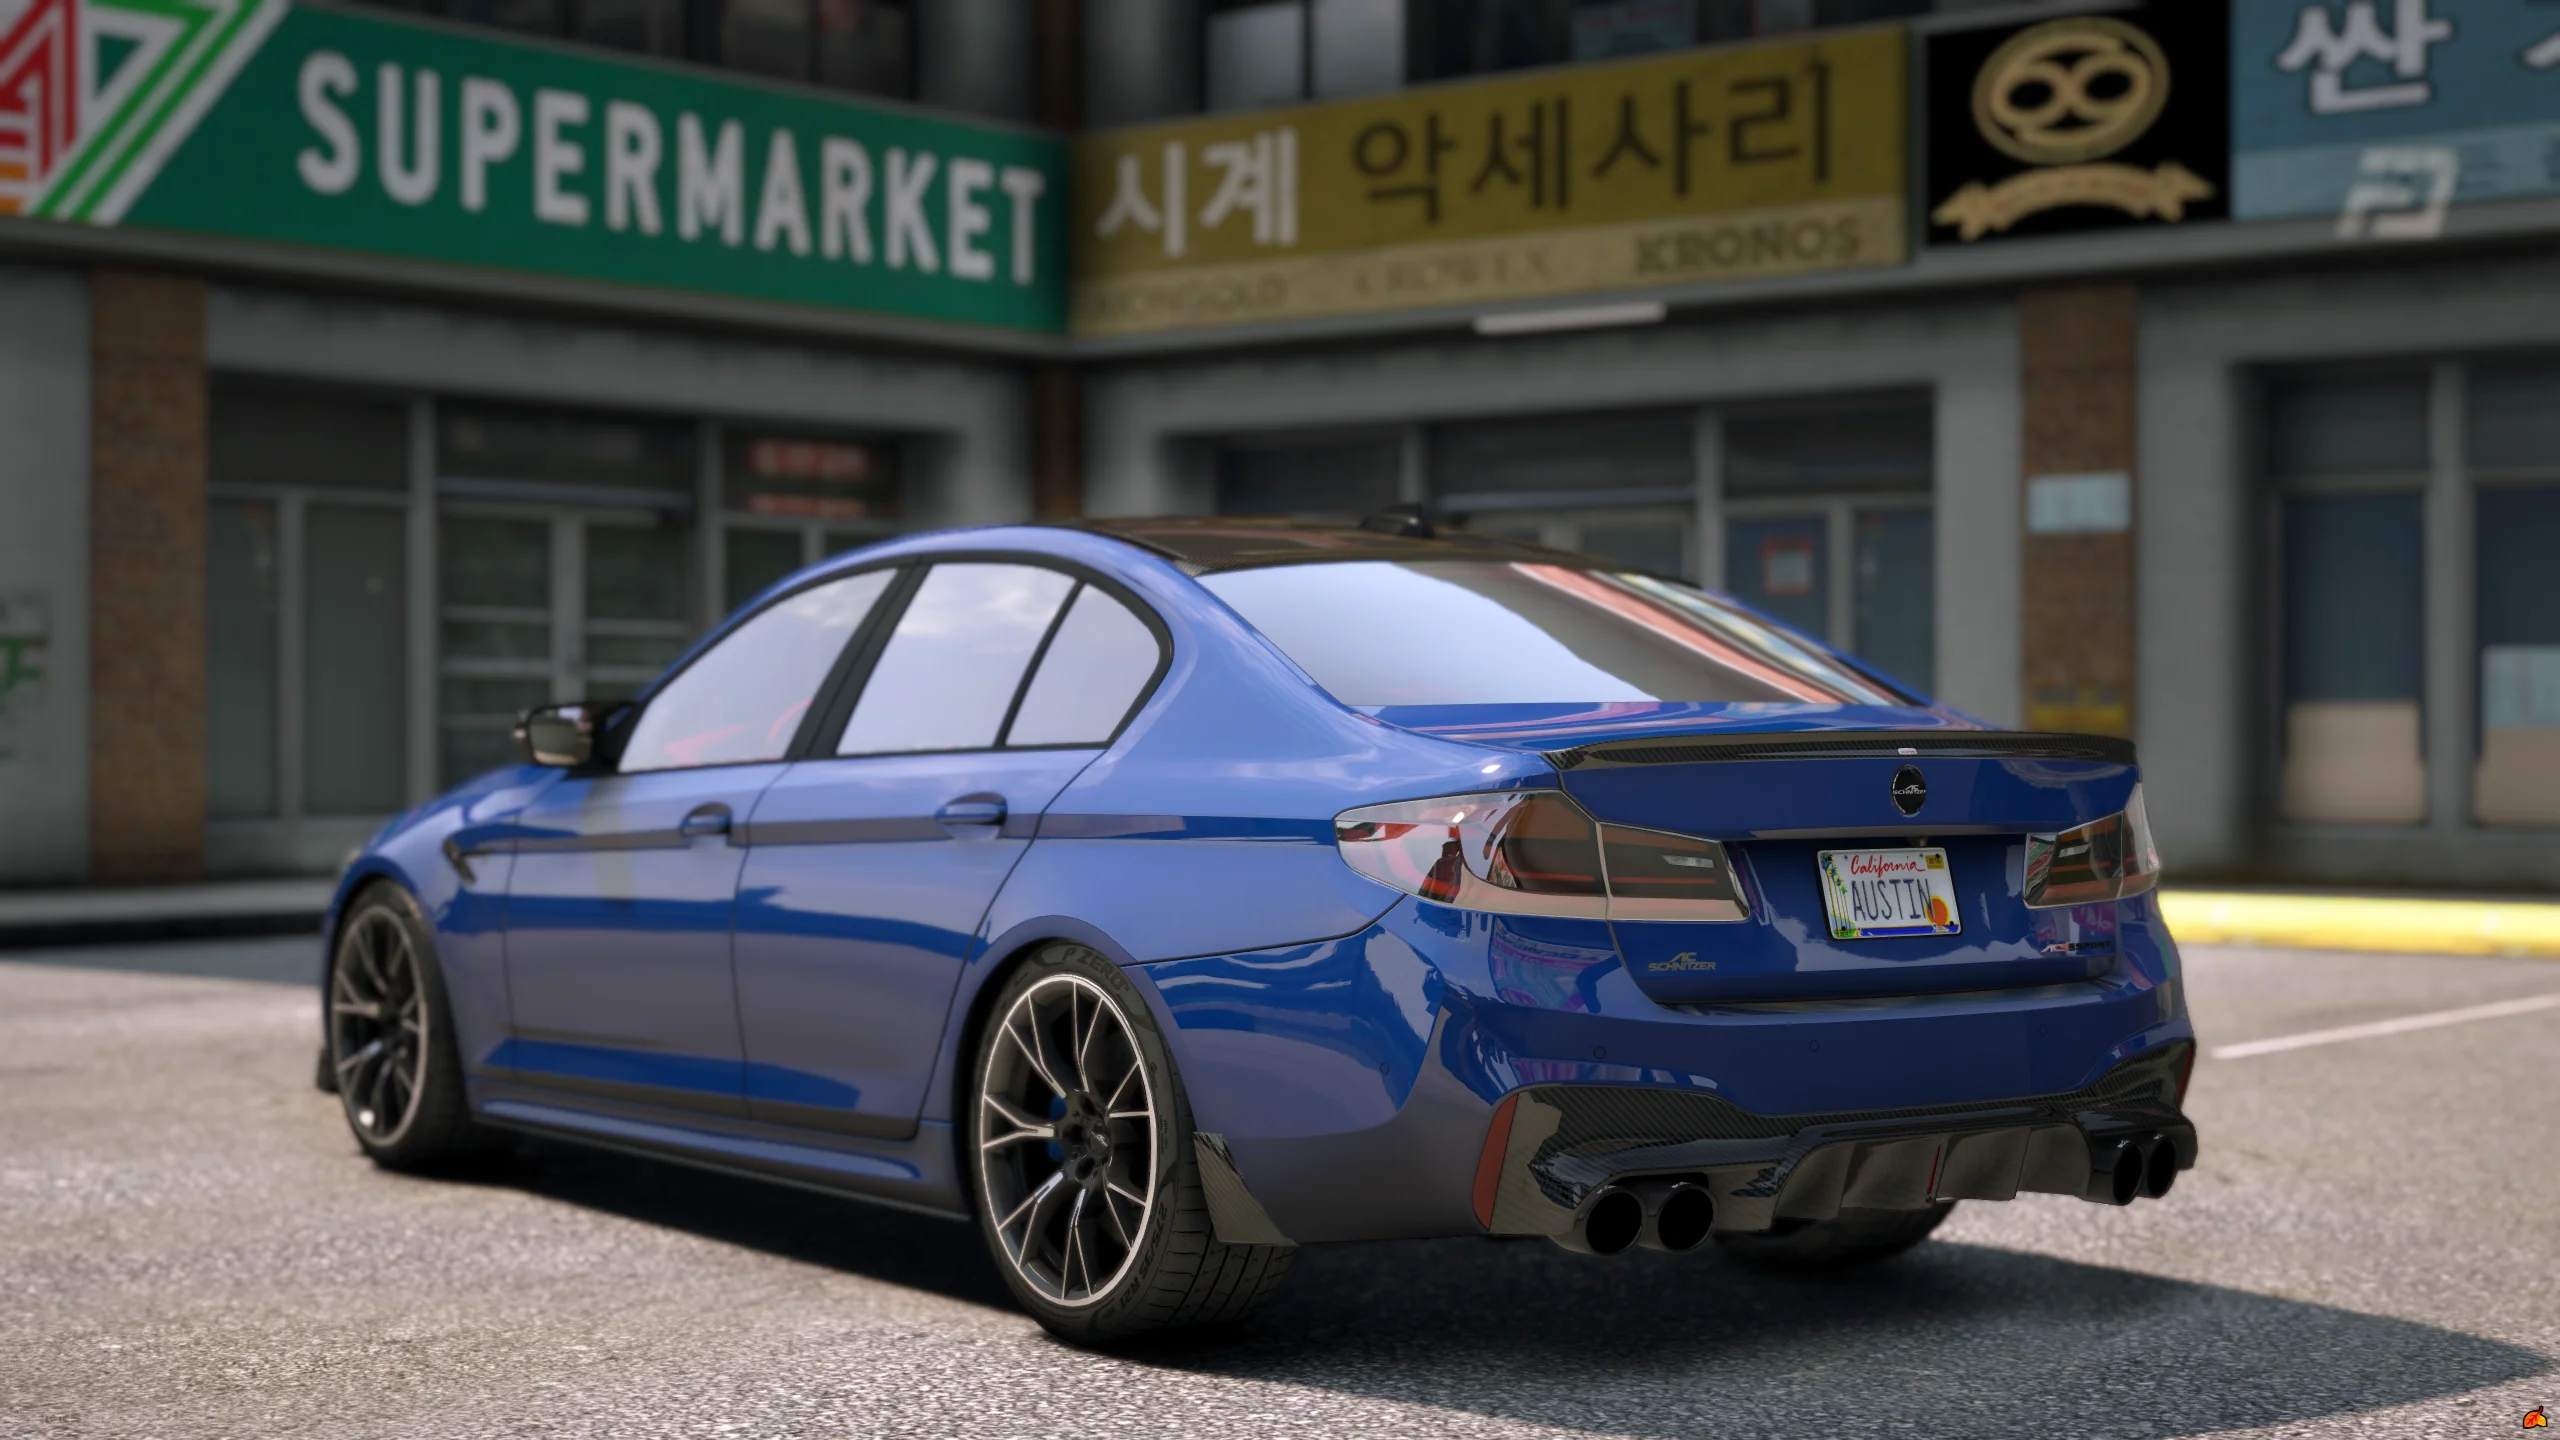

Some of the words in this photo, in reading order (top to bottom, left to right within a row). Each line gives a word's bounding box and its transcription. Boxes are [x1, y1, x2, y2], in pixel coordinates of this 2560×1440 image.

[296, 49, 1047, 287] SUPERMARKET
[1094, 126, 1299, 258] 시계
[1353, 60, 1832, 224] 악세사리
[1634, 216, 1864, 274] KRONOS
[1851, 855, 1926, 878] California
[1851, 878, 1936, 921] AUSTIN
[1077, 949, 1126, 990] ZERO
[1647, 961, 1717, 972] SCHNITZER
